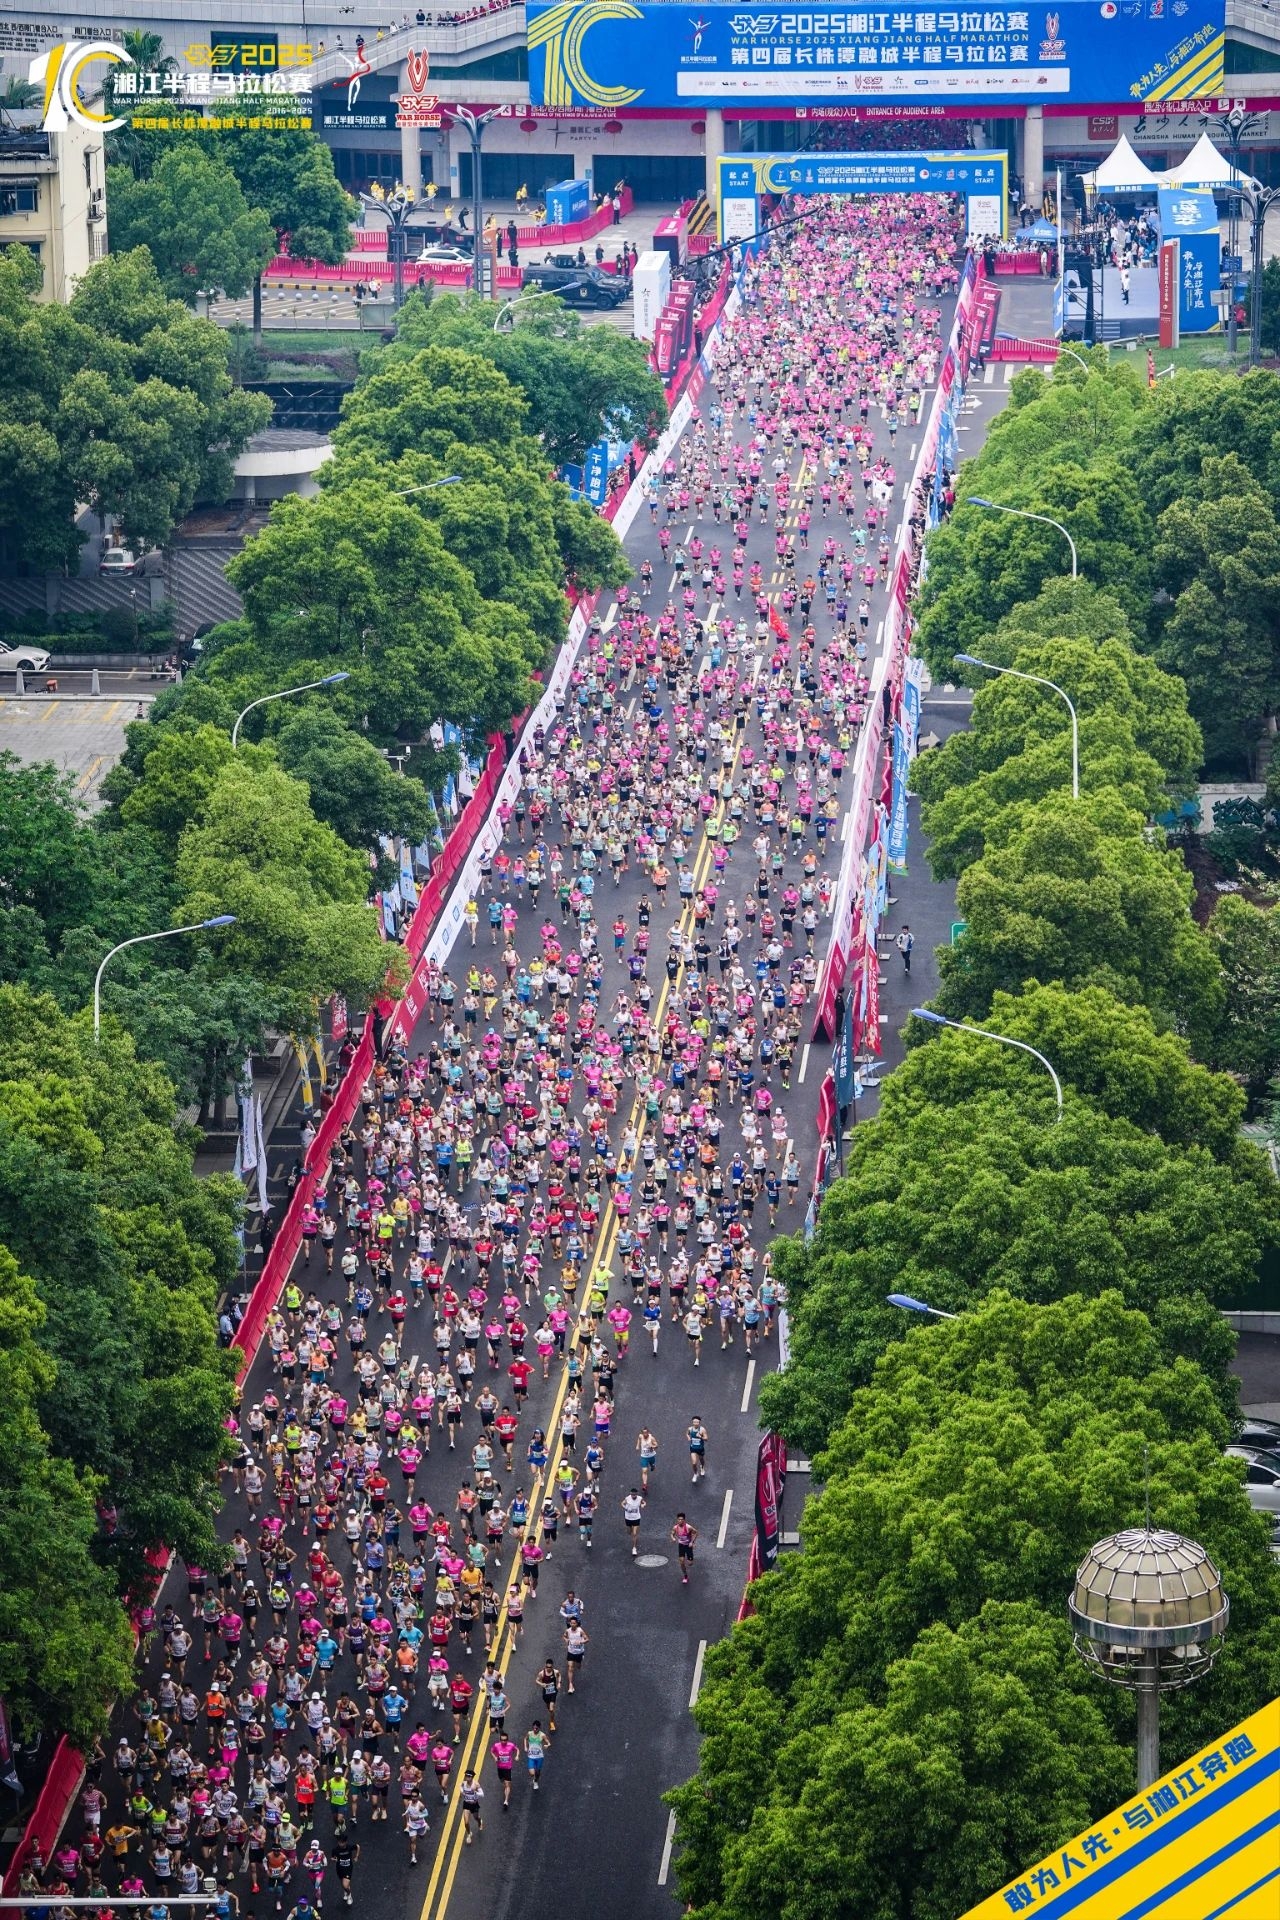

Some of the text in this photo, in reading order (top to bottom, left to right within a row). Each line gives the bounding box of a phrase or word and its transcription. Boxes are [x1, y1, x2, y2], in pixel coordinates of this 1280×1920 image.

[781, 11, 1029, 34] 2025湘江半程马拉松赛
[731, 33, 1029, 44] WAR HORSE 2025 XIANG JIANG HALF MARATHON
[731, 45, 1029, 65] 第四届长株潭融城半程马拉松赛
[866, 106, 945, 116] ENTRANCE OF AUDIENCE AREA
